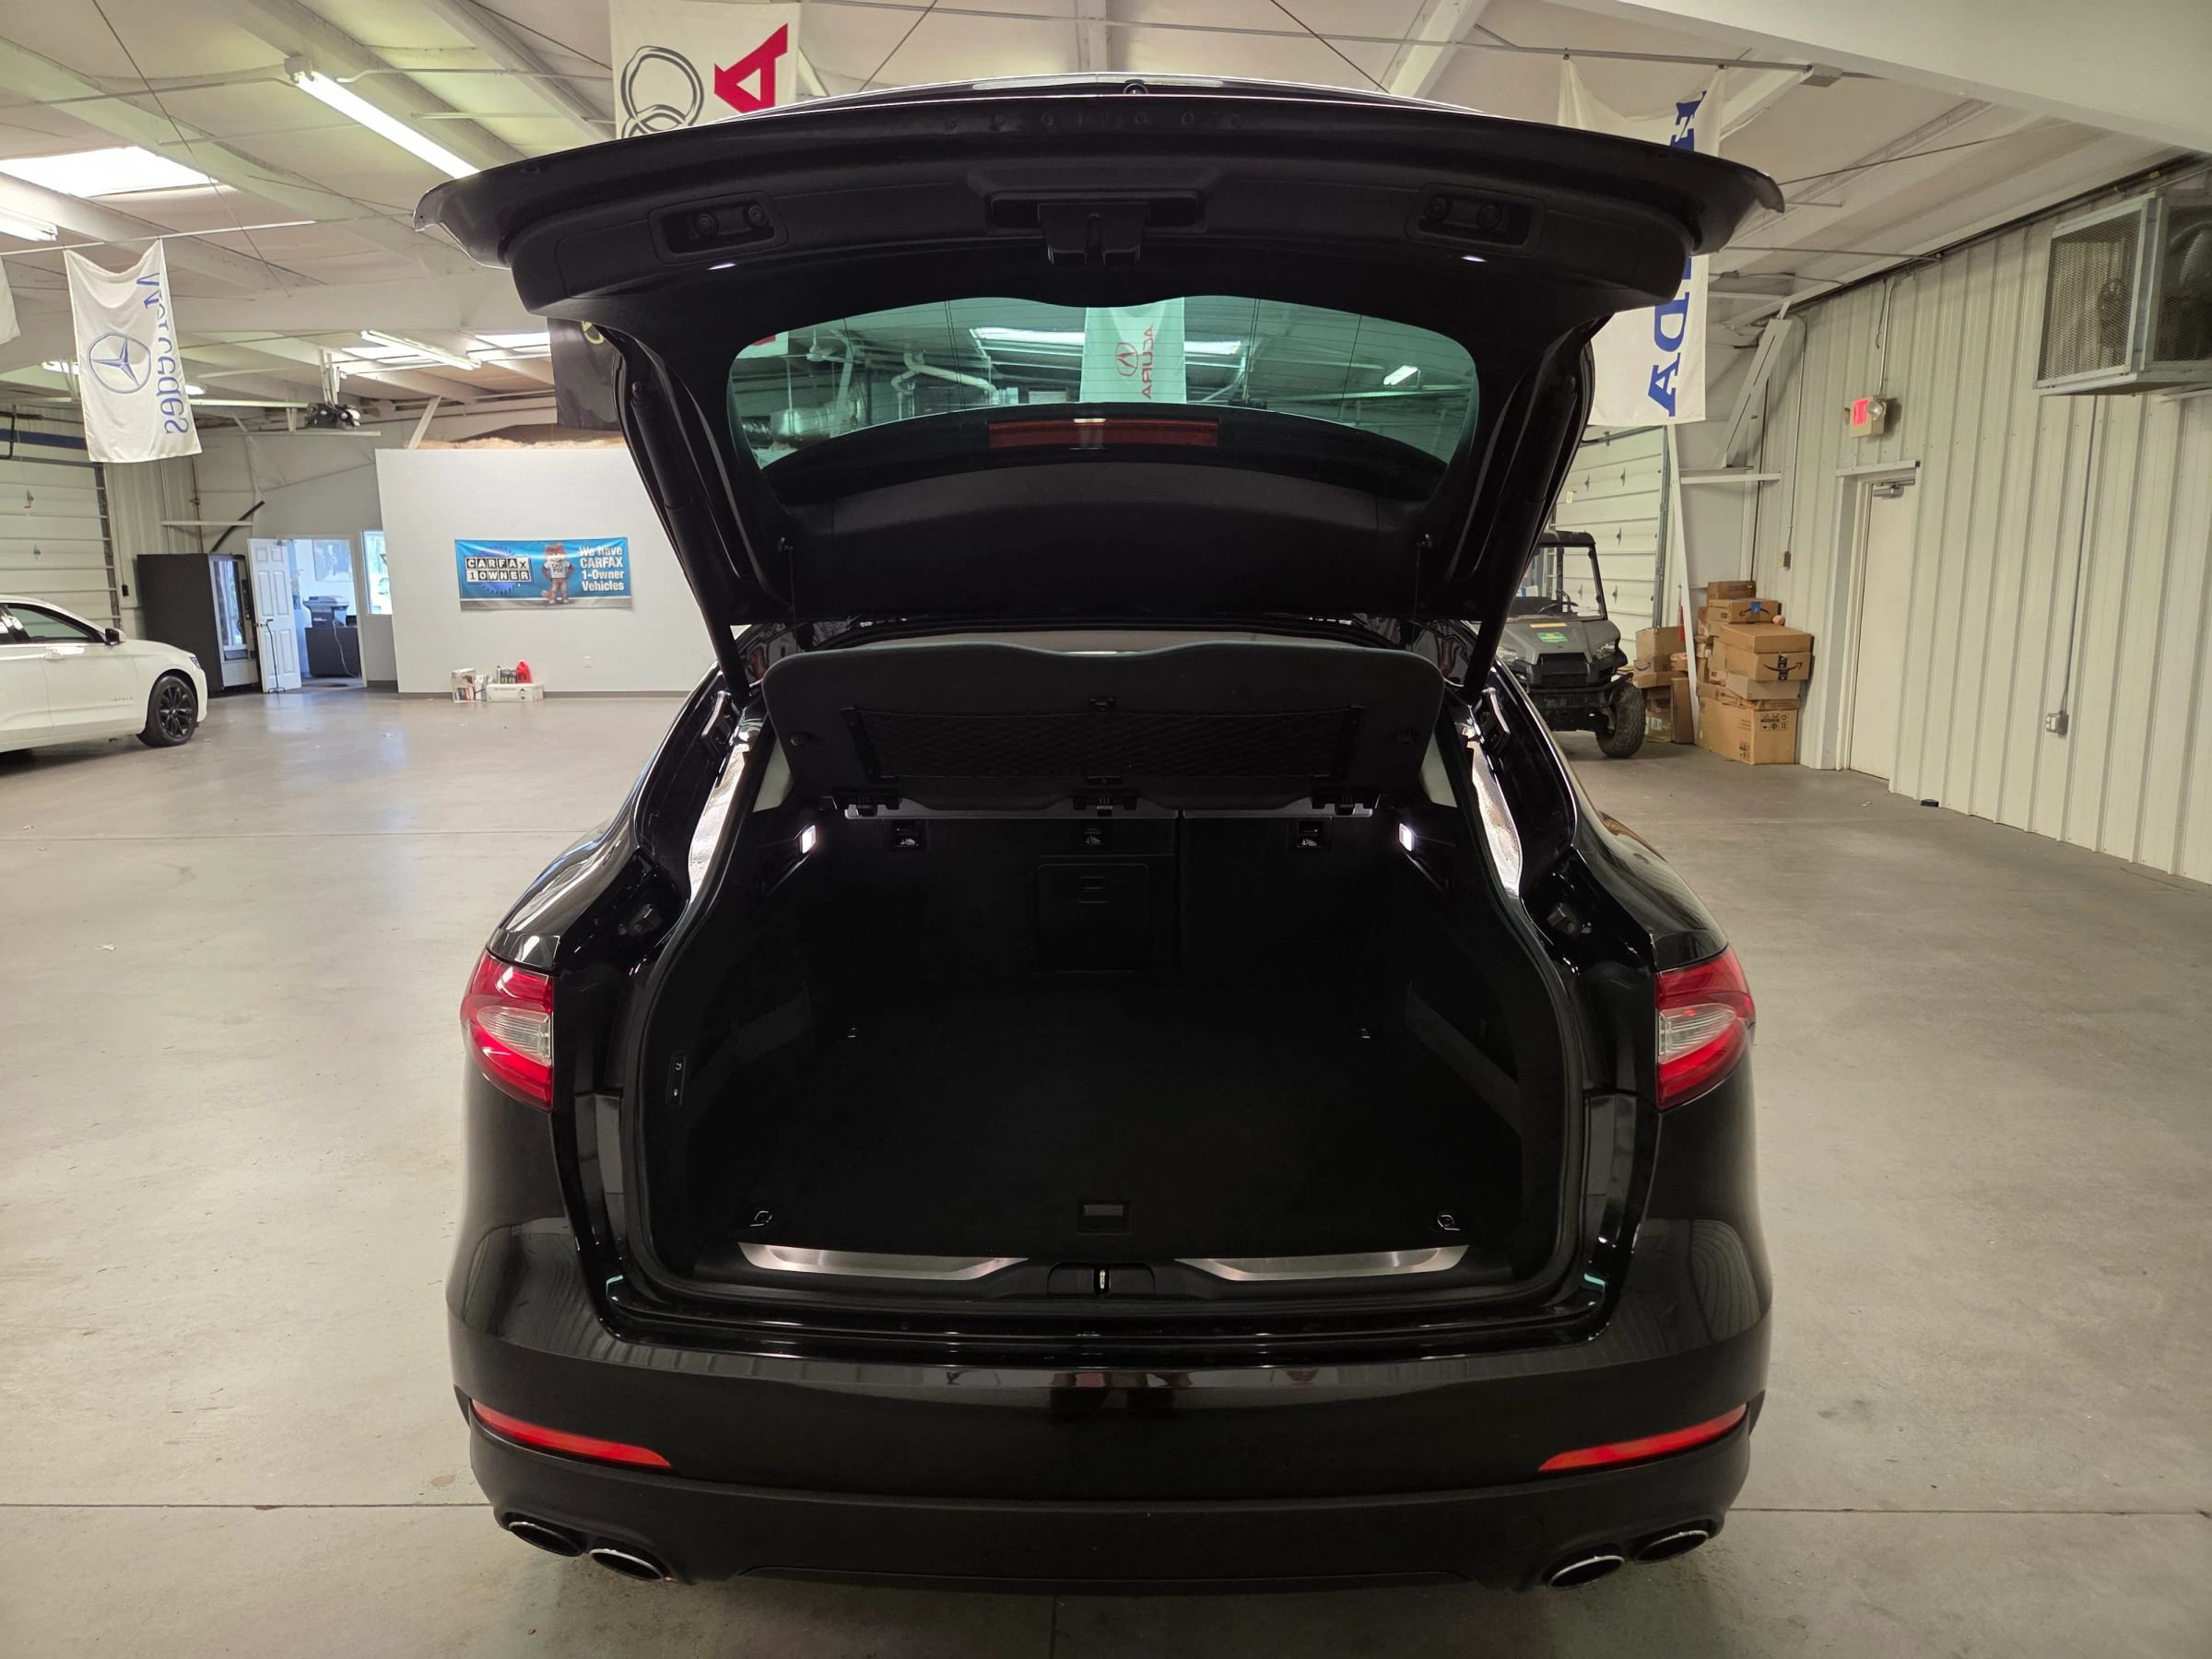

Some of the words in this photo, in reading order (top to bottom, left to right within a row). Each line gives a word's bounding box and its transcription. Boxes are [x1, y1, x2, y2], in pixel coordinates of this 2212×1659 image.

[579, 546, 595, 557] We
[597, 546, 623, 556] have
[466, 558, 527, 569] CARFAX
[580, 556, 623, 569] CARFAX
[478, 571, 529, 581] OWNER
[582, 569, 625, 580] 1-Owner
[582, 580, 625, 592] Vehicles
